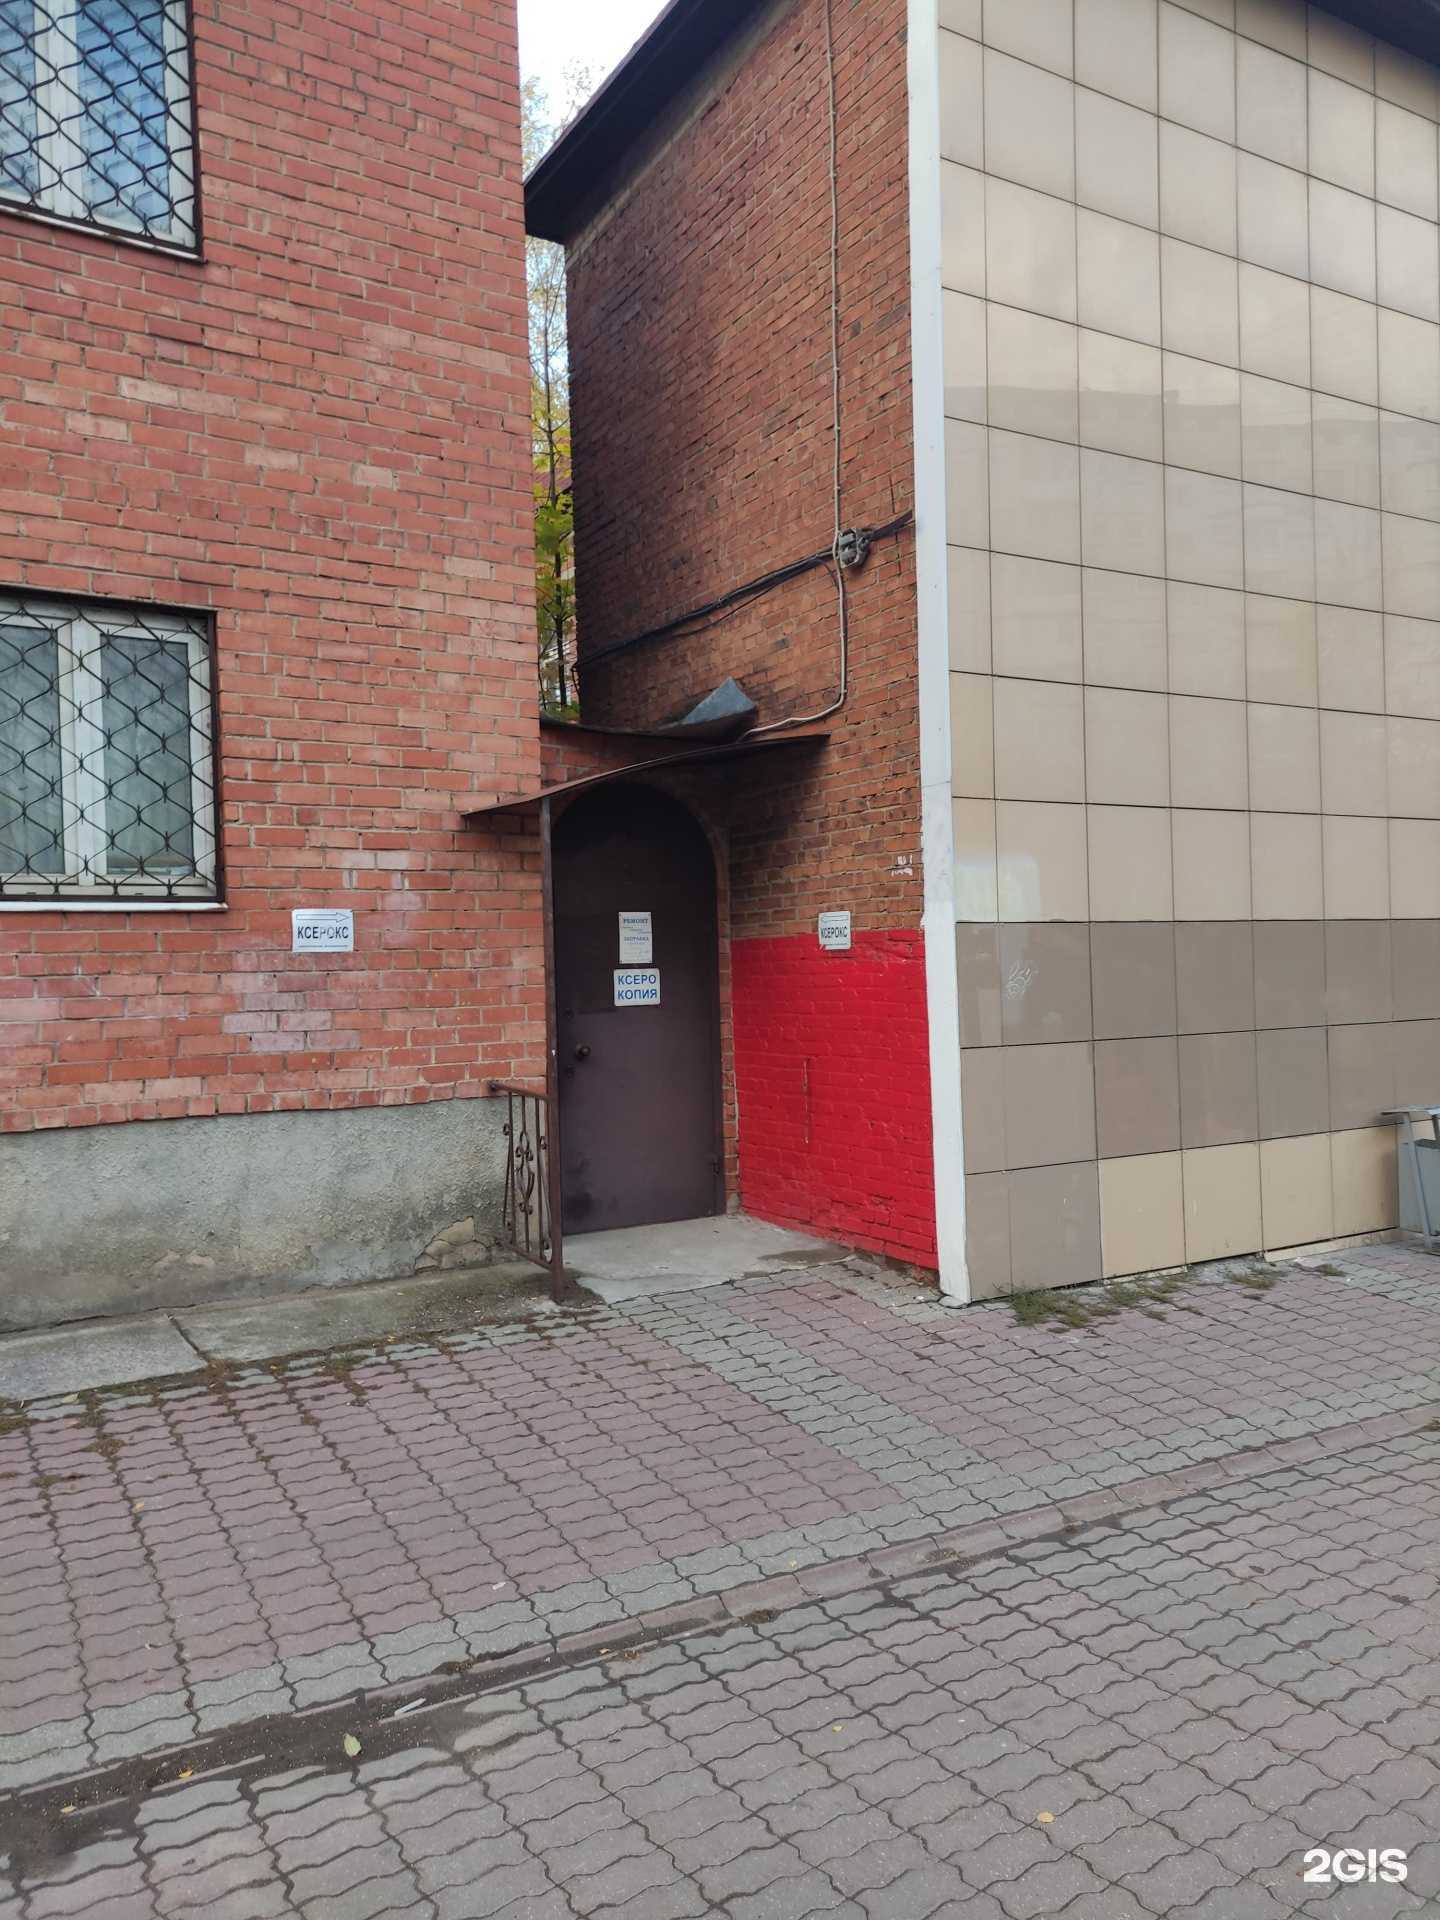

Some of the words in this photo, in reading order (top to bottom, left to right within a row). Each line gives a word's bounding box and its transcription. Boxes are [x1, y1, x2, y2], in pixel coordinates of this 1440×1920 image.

[297, 926, 349, 939] КСЕРОКС
[820, 926, 848, 938] КСЕРОКС
[618, 974, 657, 985] КСЕРО
[617, 988, 657, 1000] КОПИЯ
